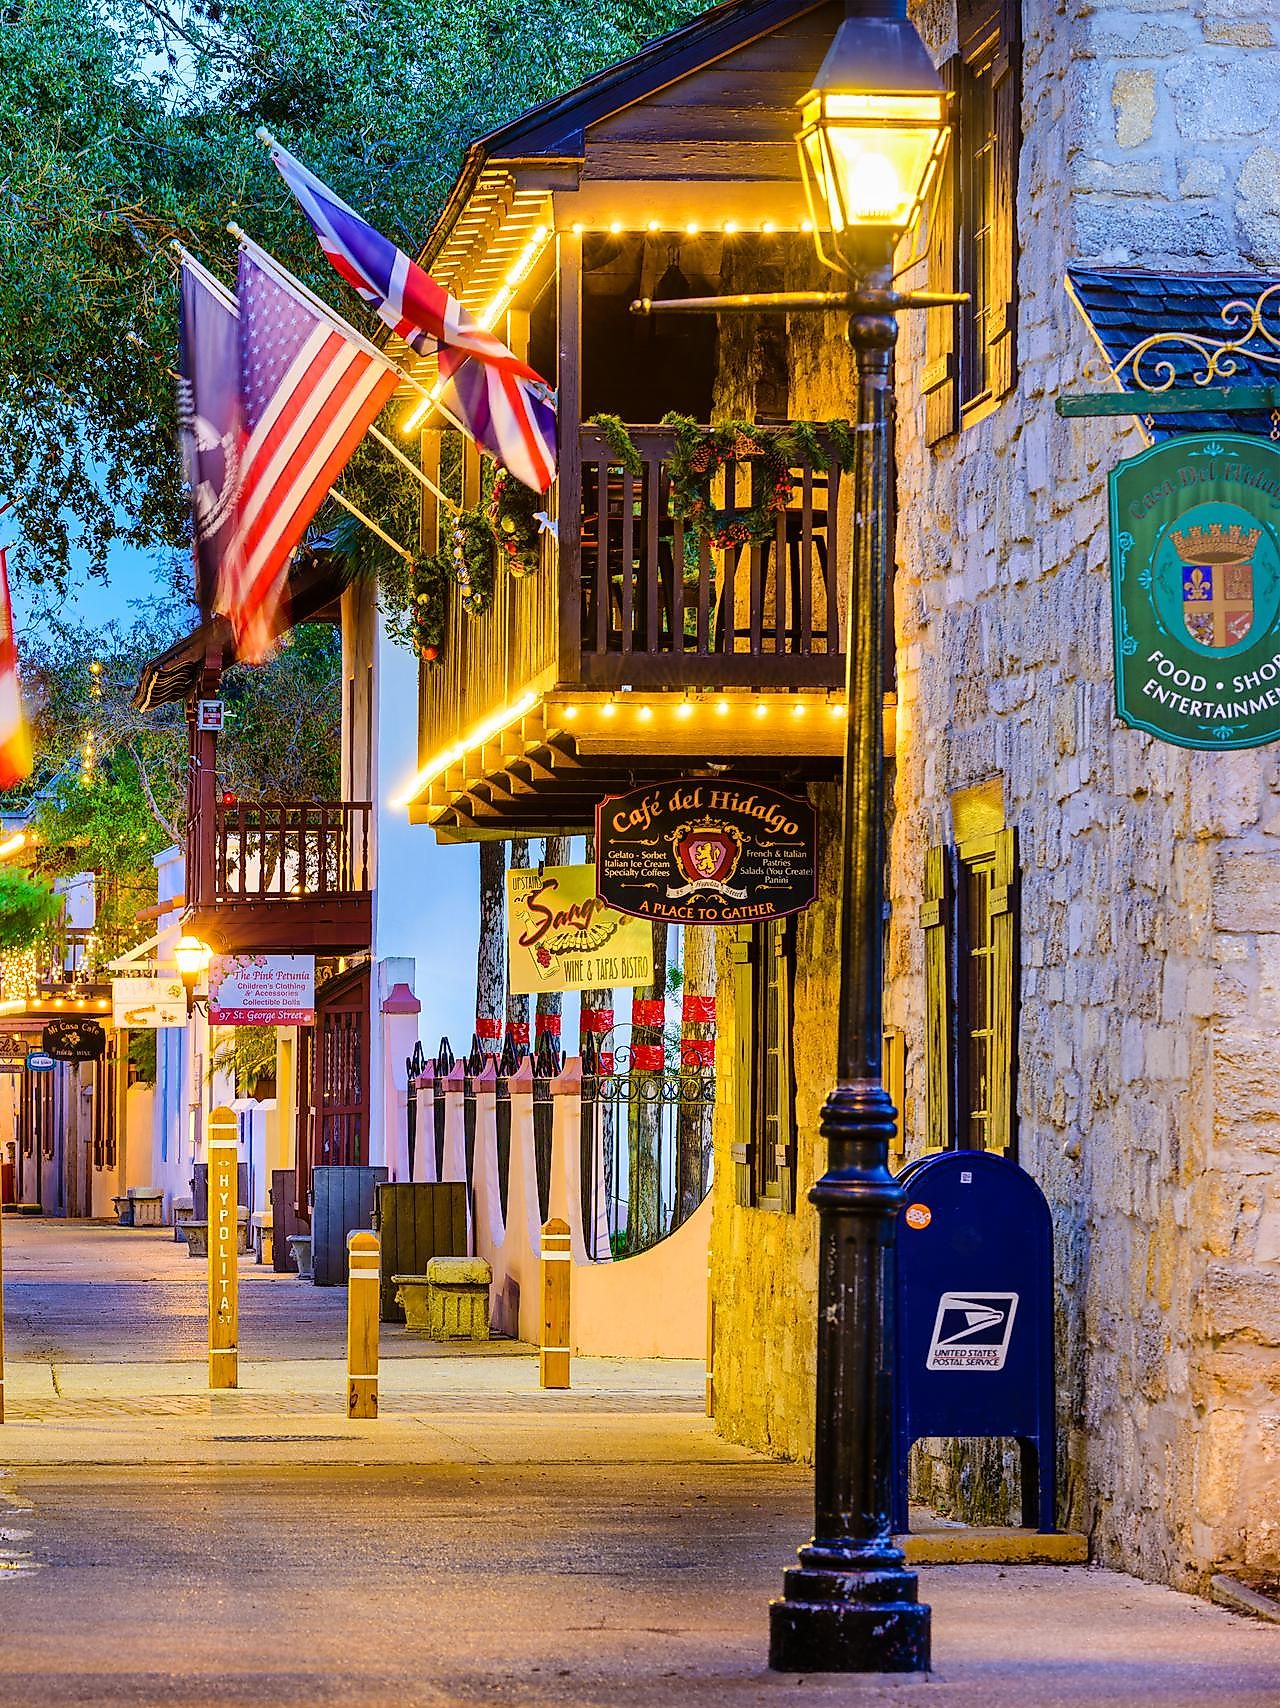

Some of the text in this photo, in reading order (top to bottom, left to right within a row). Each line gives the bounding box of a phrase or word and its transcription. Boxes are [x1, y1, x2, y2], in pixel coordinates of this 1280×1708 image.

[1128, 479, 1175, 520] Casa
[1176, 461, 1216, 487] Del
[1146, 649, 1207, 693] FOOD
[1141, 678, 1280, 719] ENTERTAINME
[612, 786, 799, 835] Café del Hidalgo
[608, 851, 634, 860] Gelato
[641, 851, 667, 860] Sorbet
[746, 849, 807, 858] French & Italian
[605, 859, 670, 868] Italian Ice Cream
[762, 858, 791, 867] Pastries
[604, 868, 670, 878] Specialty Coffees
[740, 867, 813, 877] Salads (You Create)
[512, 876, 543, 891] UPSTAIRS
[725, 887, 744, 898] Street
[639, 901, 776, 919] A PLACE TO GATHER
[235, 968, 310, 980] The Pink Petunia
[564, 956, 648, 982] WINE & TAPAS BISTRO
[275, 983, 305, 991] Clothing
[219, 1011, 304, 1023] 97 St. George Street
[48, 1024, 58, 1035] Mi
[60, 1022, 79, 1031] Casa
[219, 1174, 229, 1309] HYPOLITA
[934, 1349, 998, 1357] UNITED STATES
[966, 1359, 999, 1367] SERVICE
